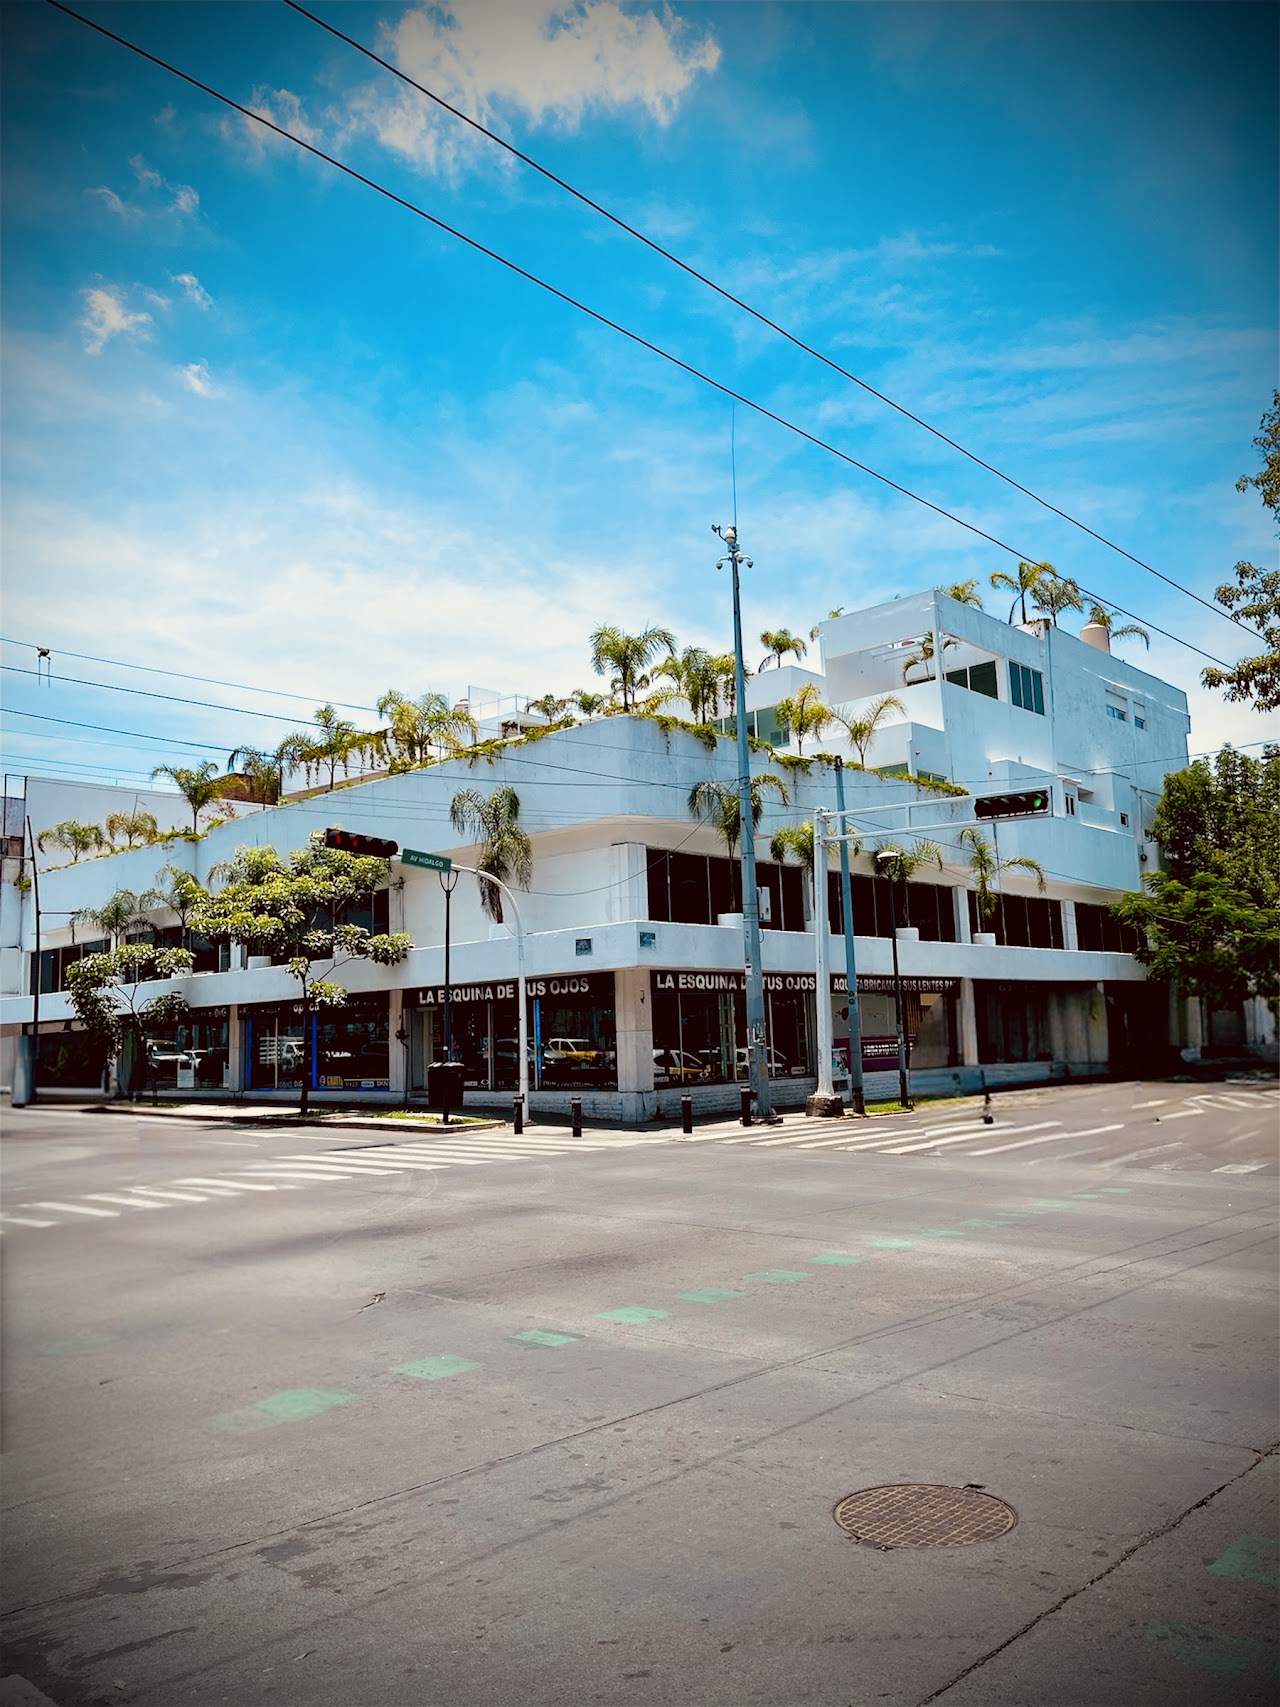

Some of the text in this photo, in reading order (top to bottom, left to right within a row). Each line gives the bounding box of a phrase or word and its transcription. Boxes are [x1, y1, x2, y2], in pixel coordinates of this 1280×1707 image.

[410, 854, 444, 868] AV HIDALGO
[656, 973, 675, 989] LA
[678, 974, 738, 990] ESQUINA
[785, 976, 816, 991] OJOS
[902, 980, 917, 991] SUS
[918, 980, 944, 992] LENTES
[419, 991, 435, 1004] LA
[497, 984, 514, 999] DE
[527, 981, 546, 997] US
[550, 977, 590, 995] OJOS
